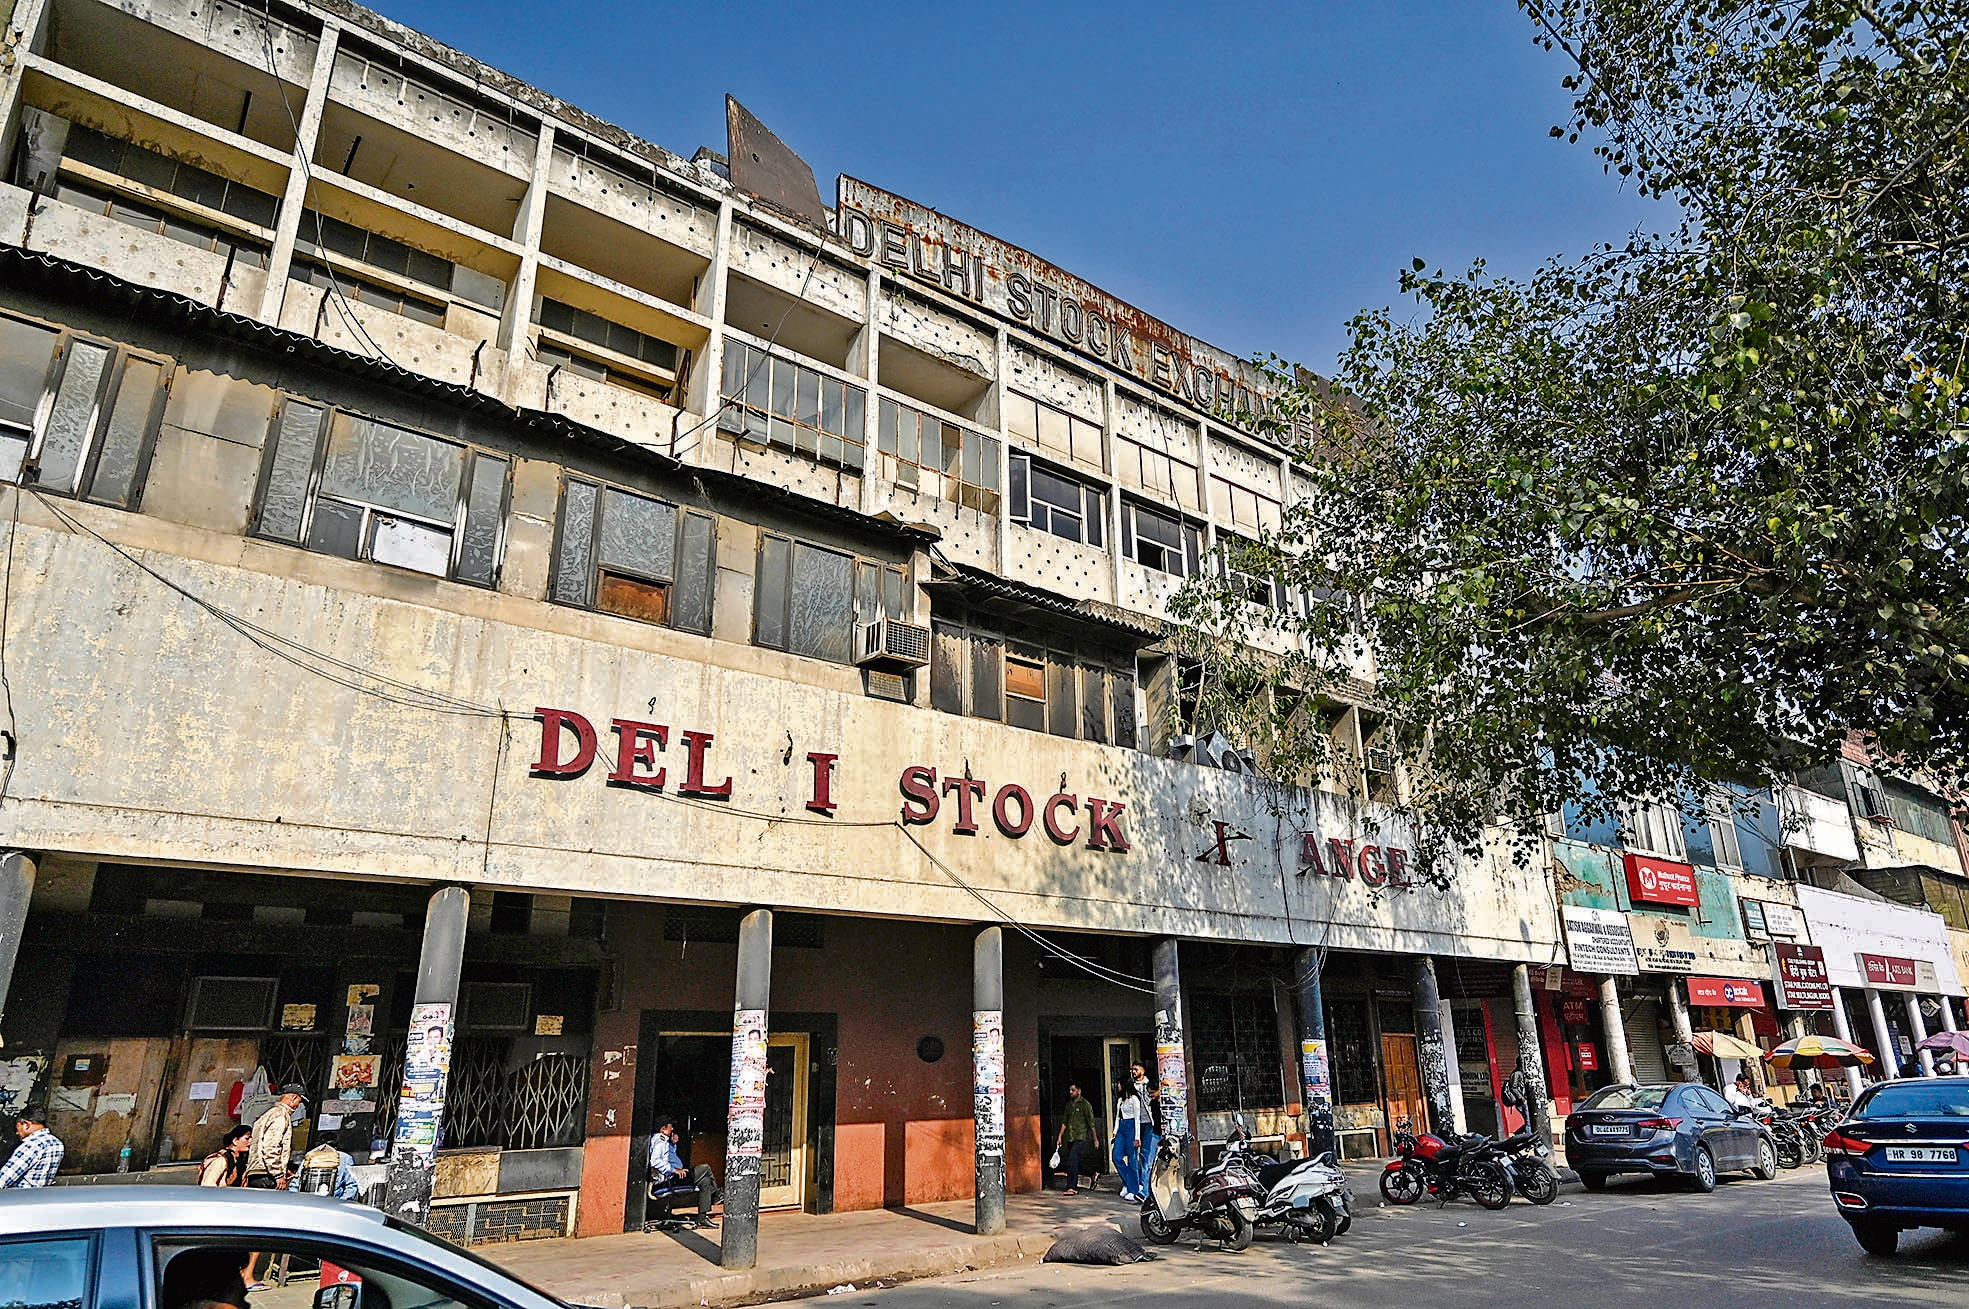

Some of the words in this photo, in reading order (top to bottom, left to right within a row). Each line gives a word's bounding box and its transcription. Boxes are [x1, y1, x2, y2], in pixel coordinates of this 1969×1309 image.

[845, 205, 983, 302] DELHI
[1006, 272, 1133, 371] STOCK
[900, 766, 1130, 854] STOCK
[1574, 943, 1595, 953] FINTECH
[1596, 945, 1630, 955] CONSULTANTS
[1901, 966, 1914, 975] BANK
[1563, 1002, 1583, 1010] ATM
[1893, 1150, 1905, 1159] HR
[1911, 1150, 1923, 1159] 98
[1930, 1150, 1955, 1160] 7768
